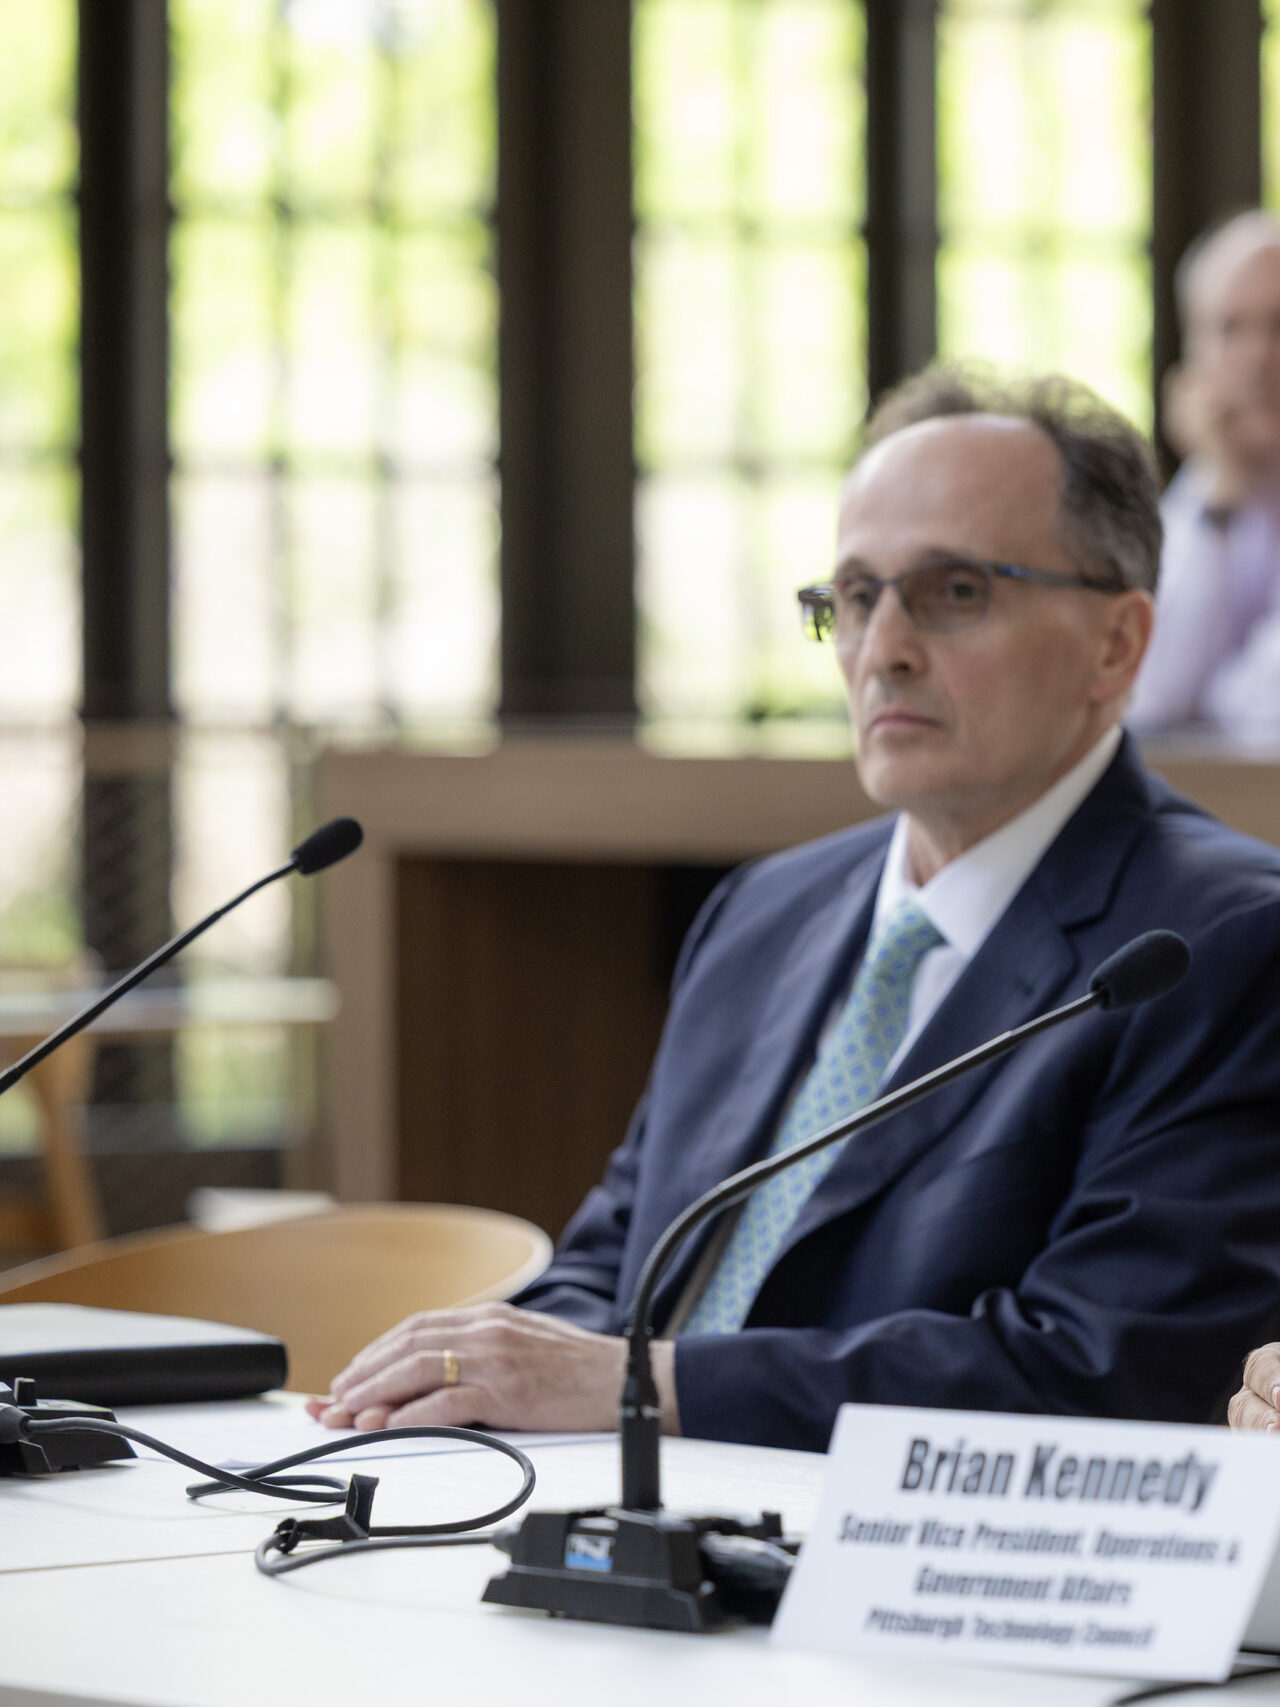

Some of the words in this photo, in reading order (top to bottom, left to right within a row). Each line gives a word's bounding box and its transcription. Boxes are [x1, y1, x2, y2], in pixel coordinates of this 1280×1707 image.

[900, 1434, 1015, 1495] Brian
[1023, 1444, 1218, 1514] Kennedy
[838, 1513, 911, 1544] Senior
[918, 1519, 965, 1549] Vice
[1094, 1529, 1219, 1564] Operations
[914, 1566, 1051, 1600] Government
[1058, 1574, 1131, 1604] Affairs
[866, 1607, 963, 1638] Pittsburgh
[973, 1614, 1075, 1645] Technology
[1082, 1622, 1156, 1647] Council
